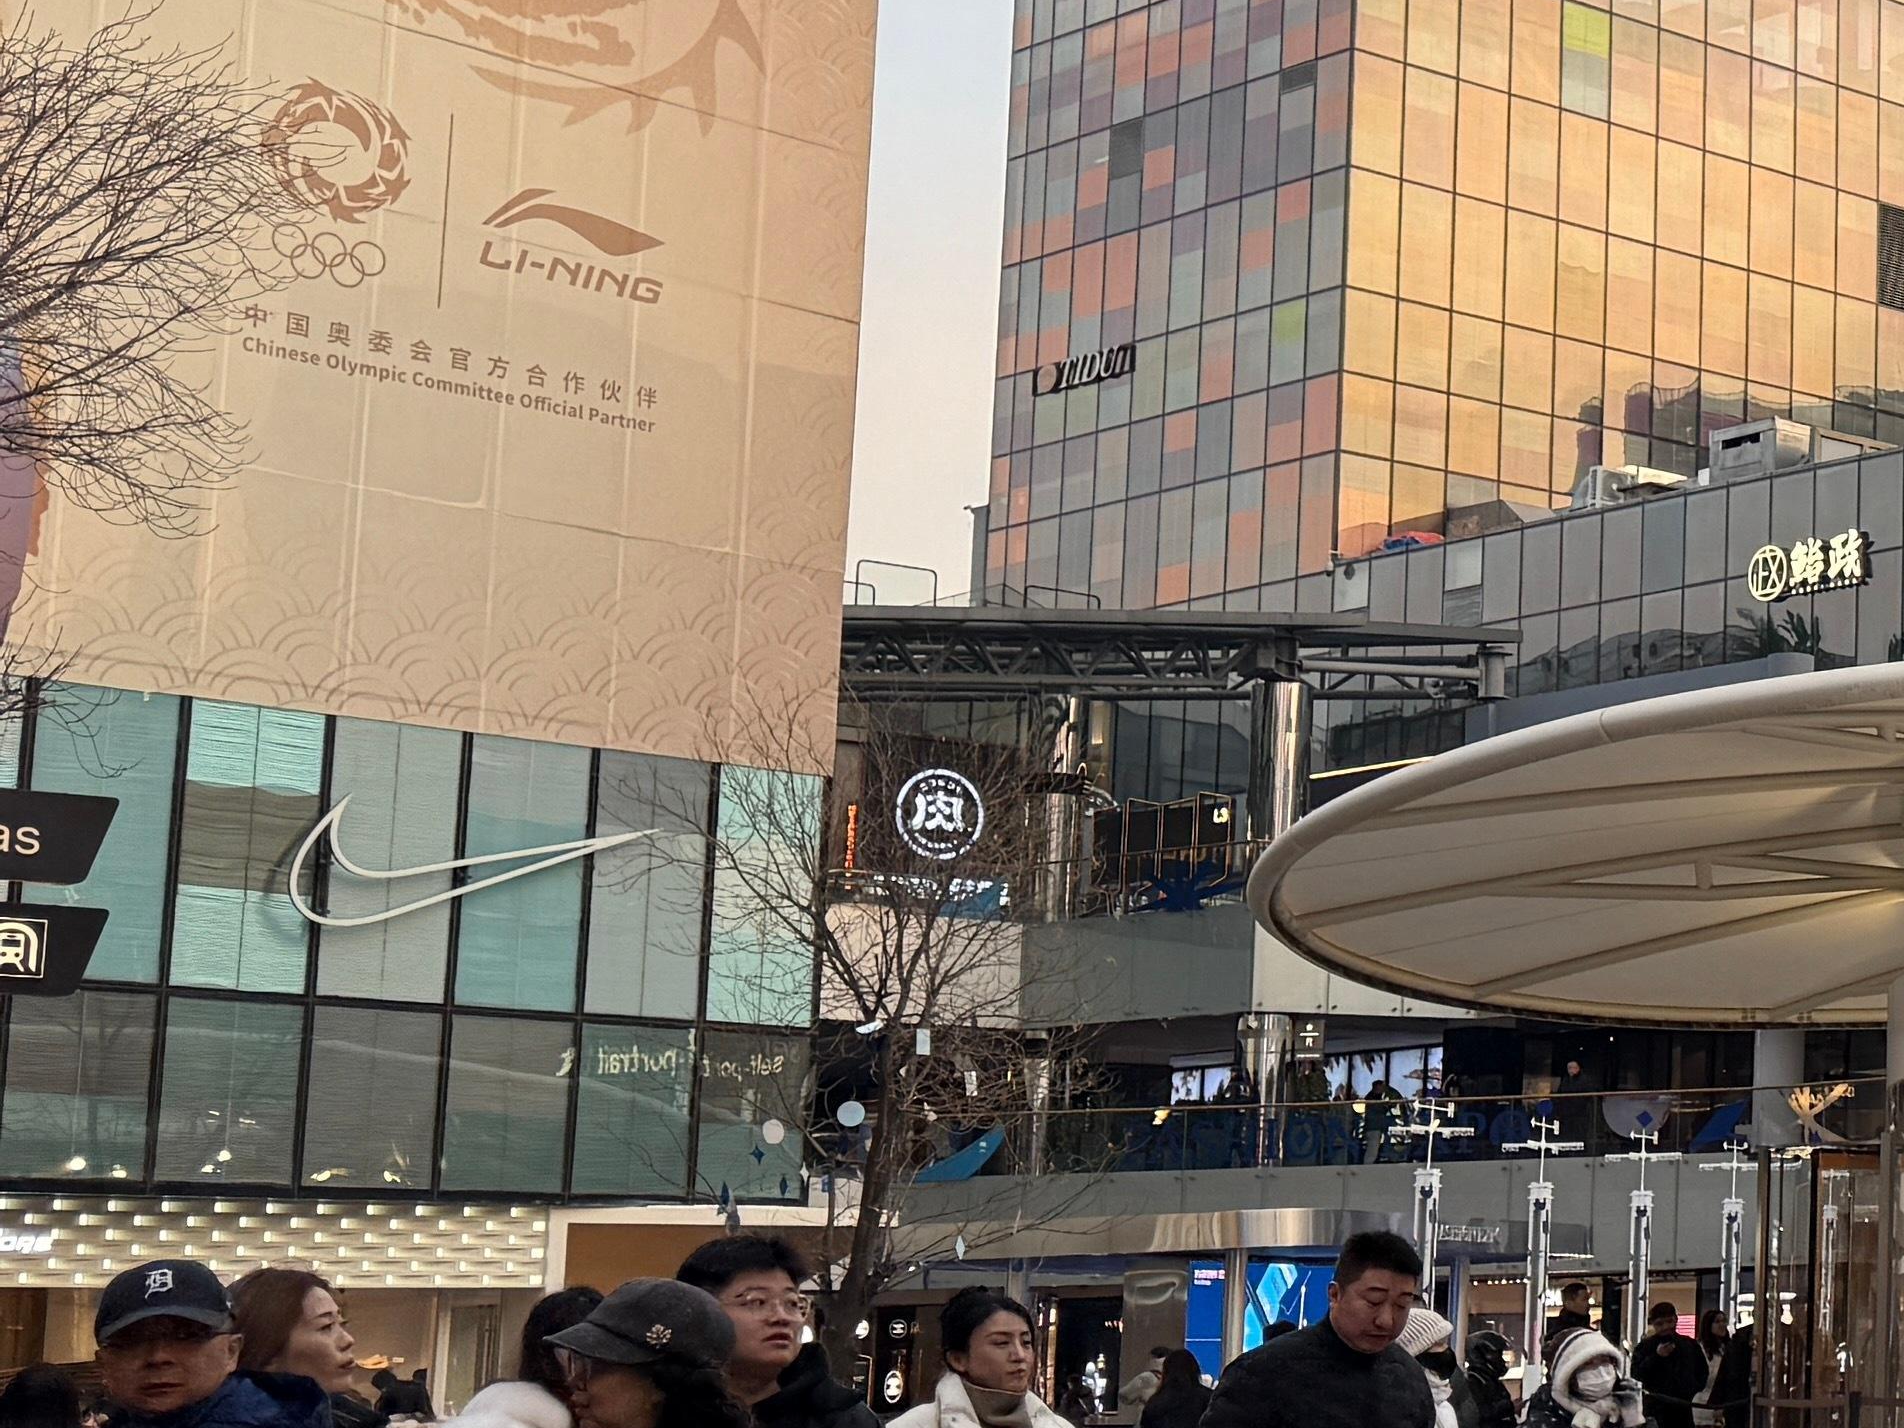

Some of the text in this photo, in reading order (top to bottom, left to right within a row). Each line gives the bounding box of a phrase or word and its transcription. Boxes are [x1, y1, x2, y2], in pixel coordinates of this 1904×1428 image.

[479, 240, 664, 304] LI-NING
[242, 335, 656, 434] Chinese Olympic Committee Official Partner
[244, 302, 658, 410] 中国奥委会官方合作伙伴
